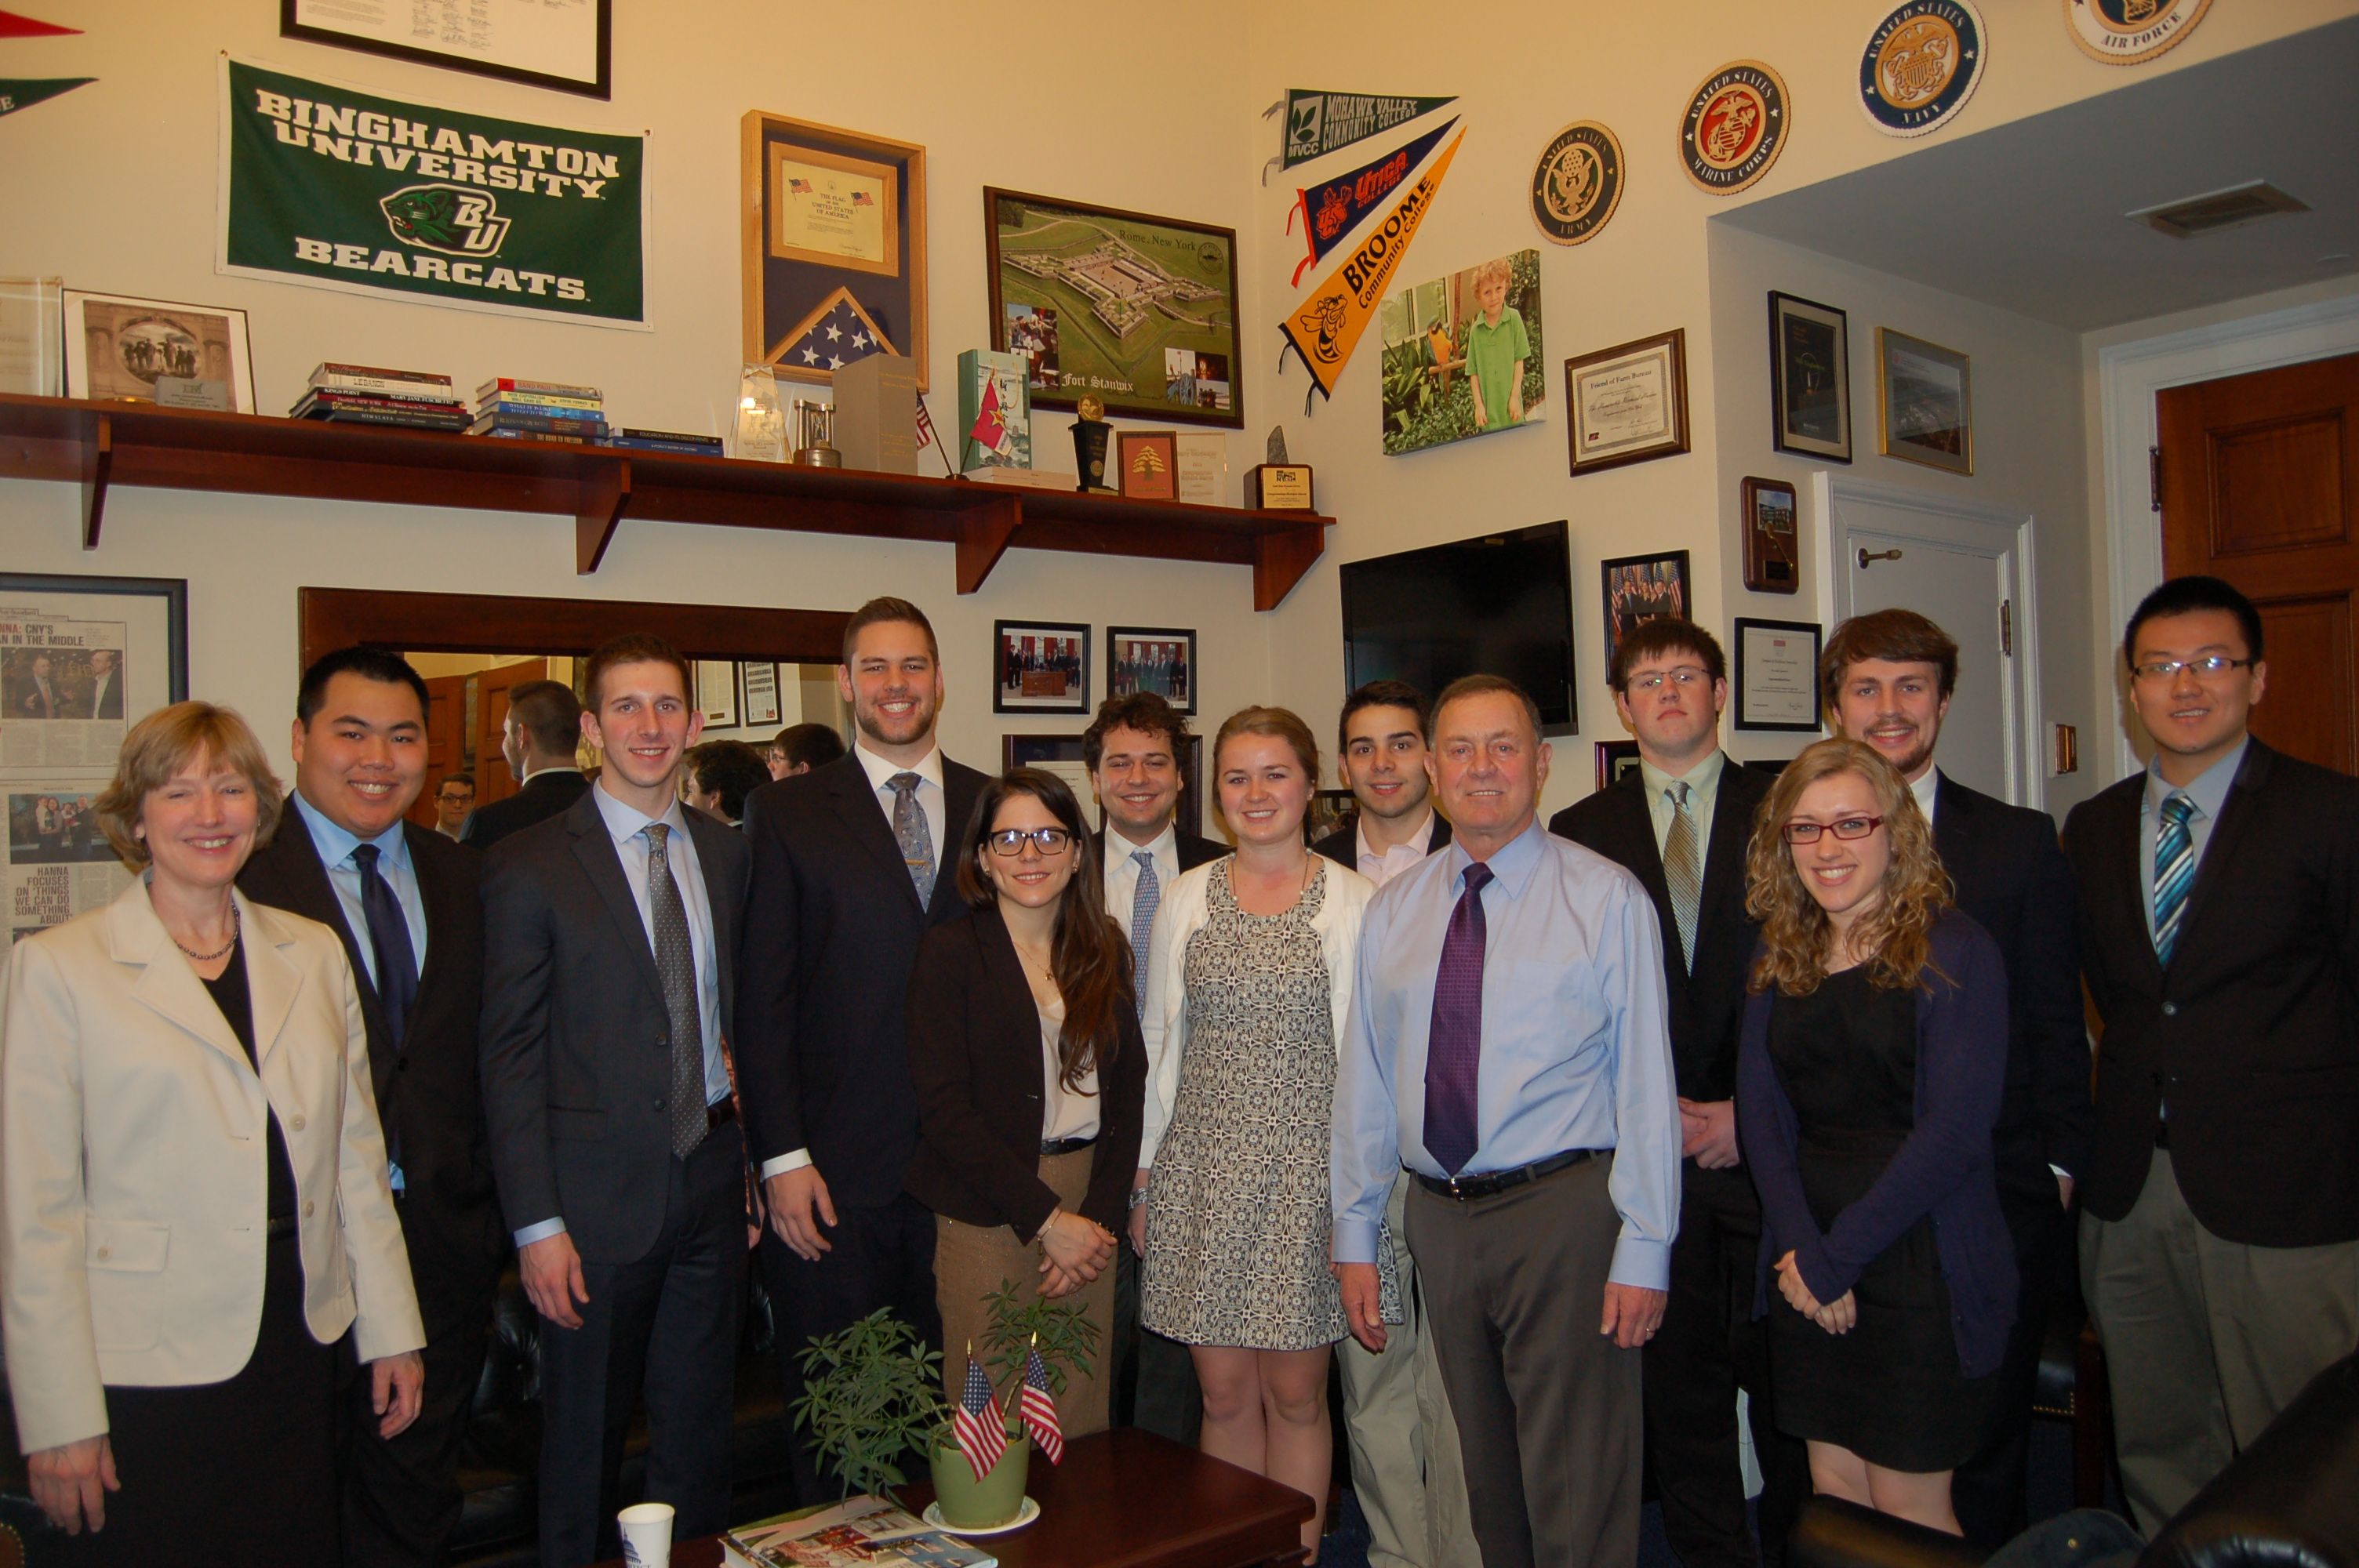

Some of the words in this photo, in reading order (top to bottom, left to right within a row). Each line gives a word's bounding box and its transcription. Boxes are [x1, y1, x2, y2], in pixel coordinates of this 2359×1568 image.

[1869, 9, 1913, 59] UNITED
[1917, 2, 1965, 29] STATES
[2101, 34, 2128, 49] AIR
[2132, 12, 2182, 48] FORCE
[1325, 95, 1373, 124] MOHAWK
[1376, 98, 1418, 116] VALLEY
[1690, 74, 1730, 118] UNITED
[1733, 71, 1773, 99] STATES
[256, 88, 620, 178] BINGHAMTON
[1322, 115, 1376, 152] COMMUNITY
[1378, 108, 1418, 129] COLLEGE
[273, 119, 606, 200] UNIVERSITY
[1288, 141, 1320, 158] MVCC
[1542, 132, 1573, 170] UNITED
[1693, 157, 1735, 183] MARINE
[1738, 136, 1774, 178] CORPS
[1354, 151, 1408, 202] UTICA
[1358, 172, 1404, 209] COLLEGE
[812, 201, 833, 211] UNITED
[834, 205, 854, 215] STATES
[1152, 235, 1173, 248] New
[1176, 239, 1197, 252] York
[1342, 176, 1431, 296] BROOME
[1358, 234, 1405, 310] Community
[1404, 183, 1435, 234] College
[295, 237, 587, 301] BEARCATS
[1061, 372, 1086, 387] Fort
[1090, 376, 1134, 392] Stanwix
[1590, 379, 1608, 390] Friend
[1631, 370, 1652, 379] Bureau
[13, 635, 23, 645] IN
[27, 635, 45, 645] THE
[48, 636, 84, 646] MIDDLE
[25, 623, 54, 635] CNY'S
[27, 877, 69, 887] FOCUSES
[37, 866, 69, 877] HANNA
[16, 887, 29, 896] ON
[33, 885, 70, 895] 'THINGS
[16, 896, 30, 906] WE
[35, 895, 53, 906] CAN
[57, 895, 70, 904] DO
[15, 905, 70, 916] SOMETHING
